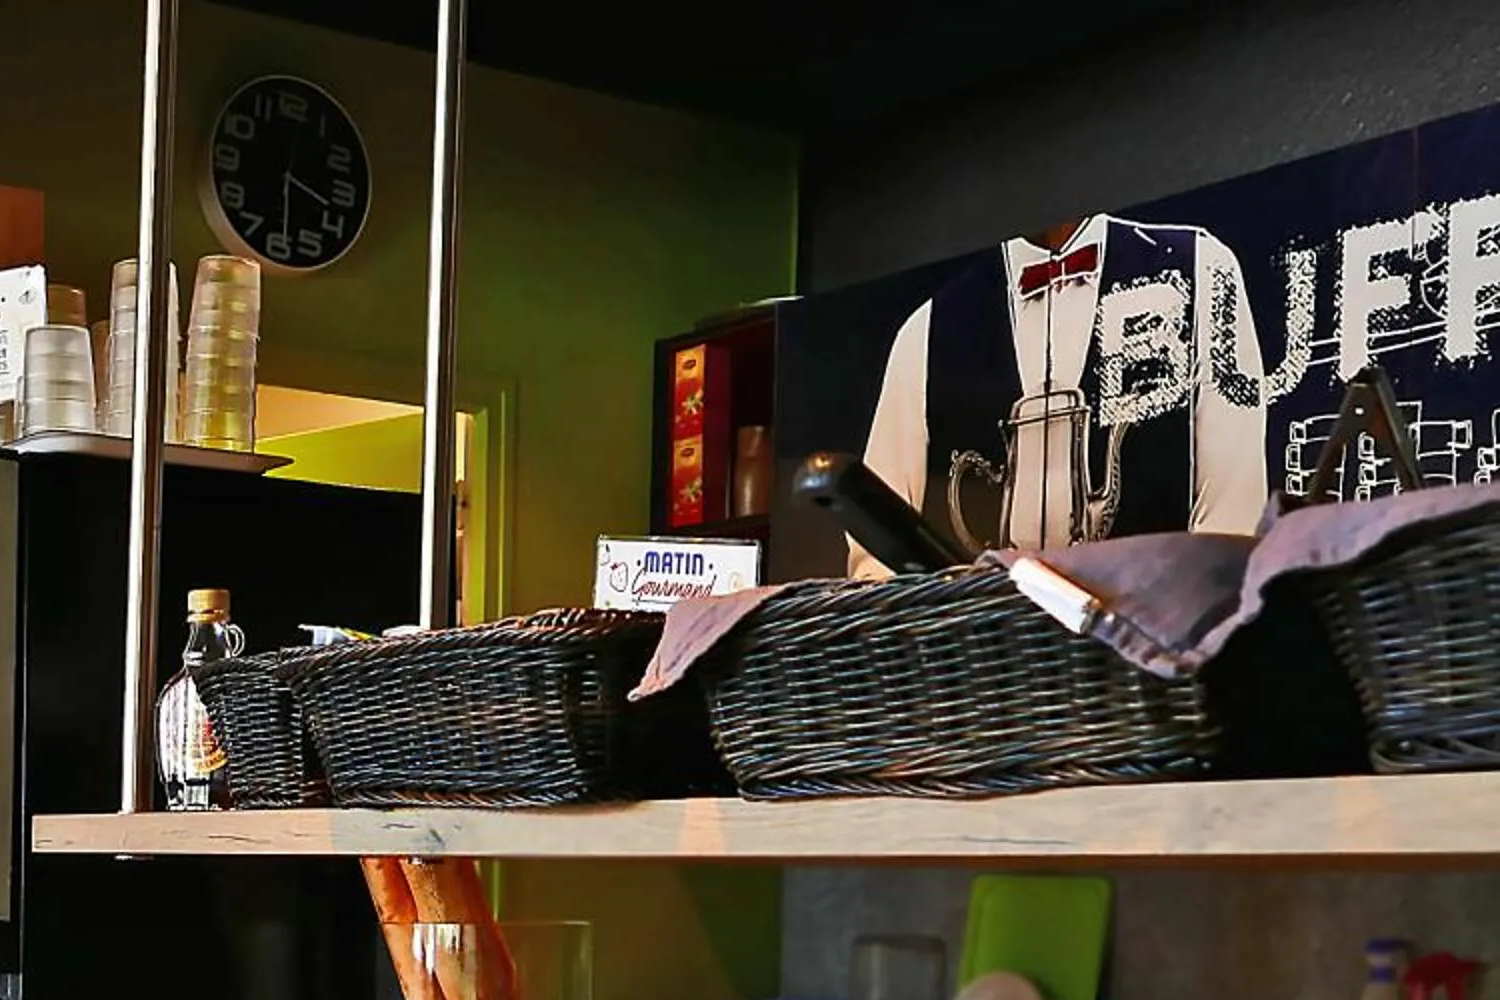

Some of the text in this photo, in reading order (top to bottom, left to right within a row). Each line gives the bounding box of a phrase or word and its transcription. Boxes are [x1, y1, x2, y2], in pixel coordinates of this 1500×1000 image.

[277, 90, 309, 122] 12
[215, 144, 240, 172] 9
[327, 144, 351, 173] 2
[221, 181, 245, 210] 8
[332, 179, 356, 208] 3
[239, 210, 264, 237] 7
[321, 209, 344, 239] 4
[266, 232, 292, 260] 6
[297, 228, 324, 258] 5
[645, 551, 704, 576] MATIN
